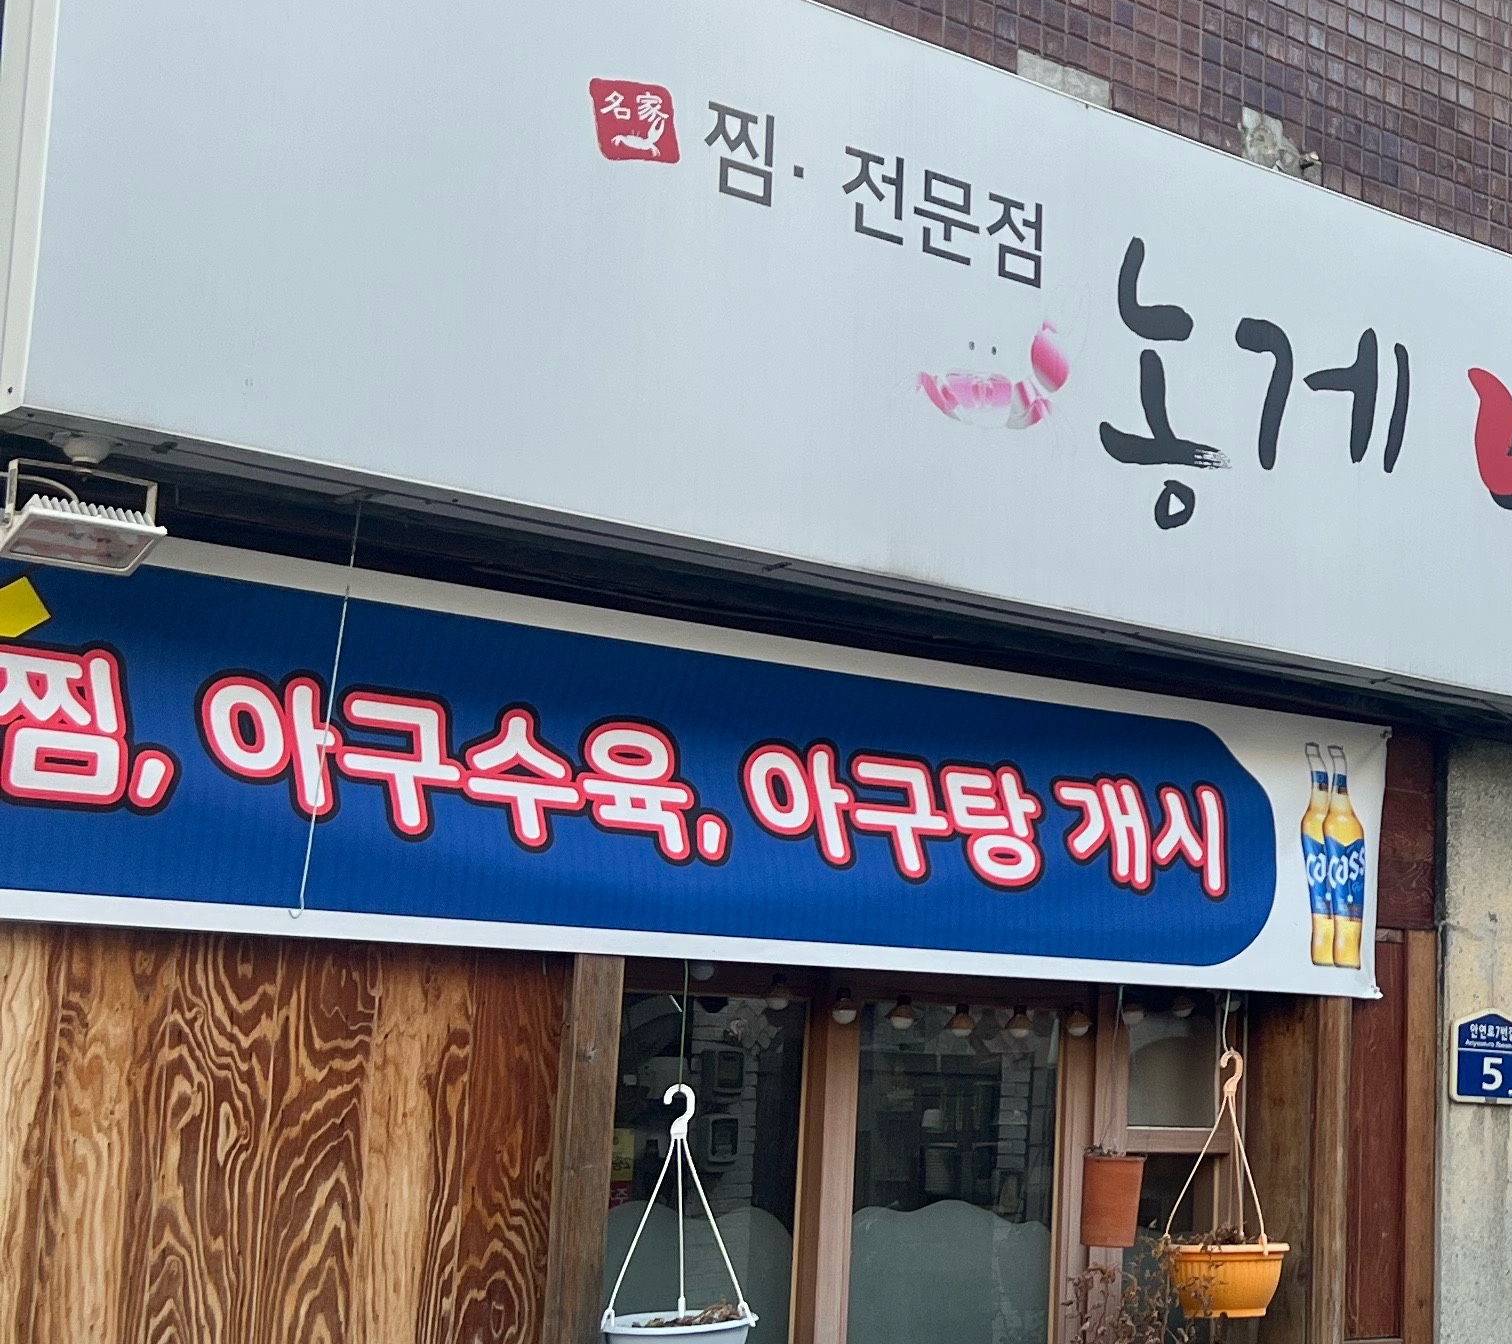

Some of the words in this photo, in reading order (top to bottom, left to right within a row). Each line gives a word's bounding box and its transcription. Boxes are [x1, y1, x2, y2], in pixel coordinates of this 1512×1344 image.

[841, 146, 1043, 288] 전문점
[1099, 237, 1410, 529] 농게
[201, 675, 730, 862] 아구수육,
[743, 744, 1042, 886] 아구탕
[1054, 778, 1226, 897] 개시
[1481, 1056, 1503, 1091] 5
